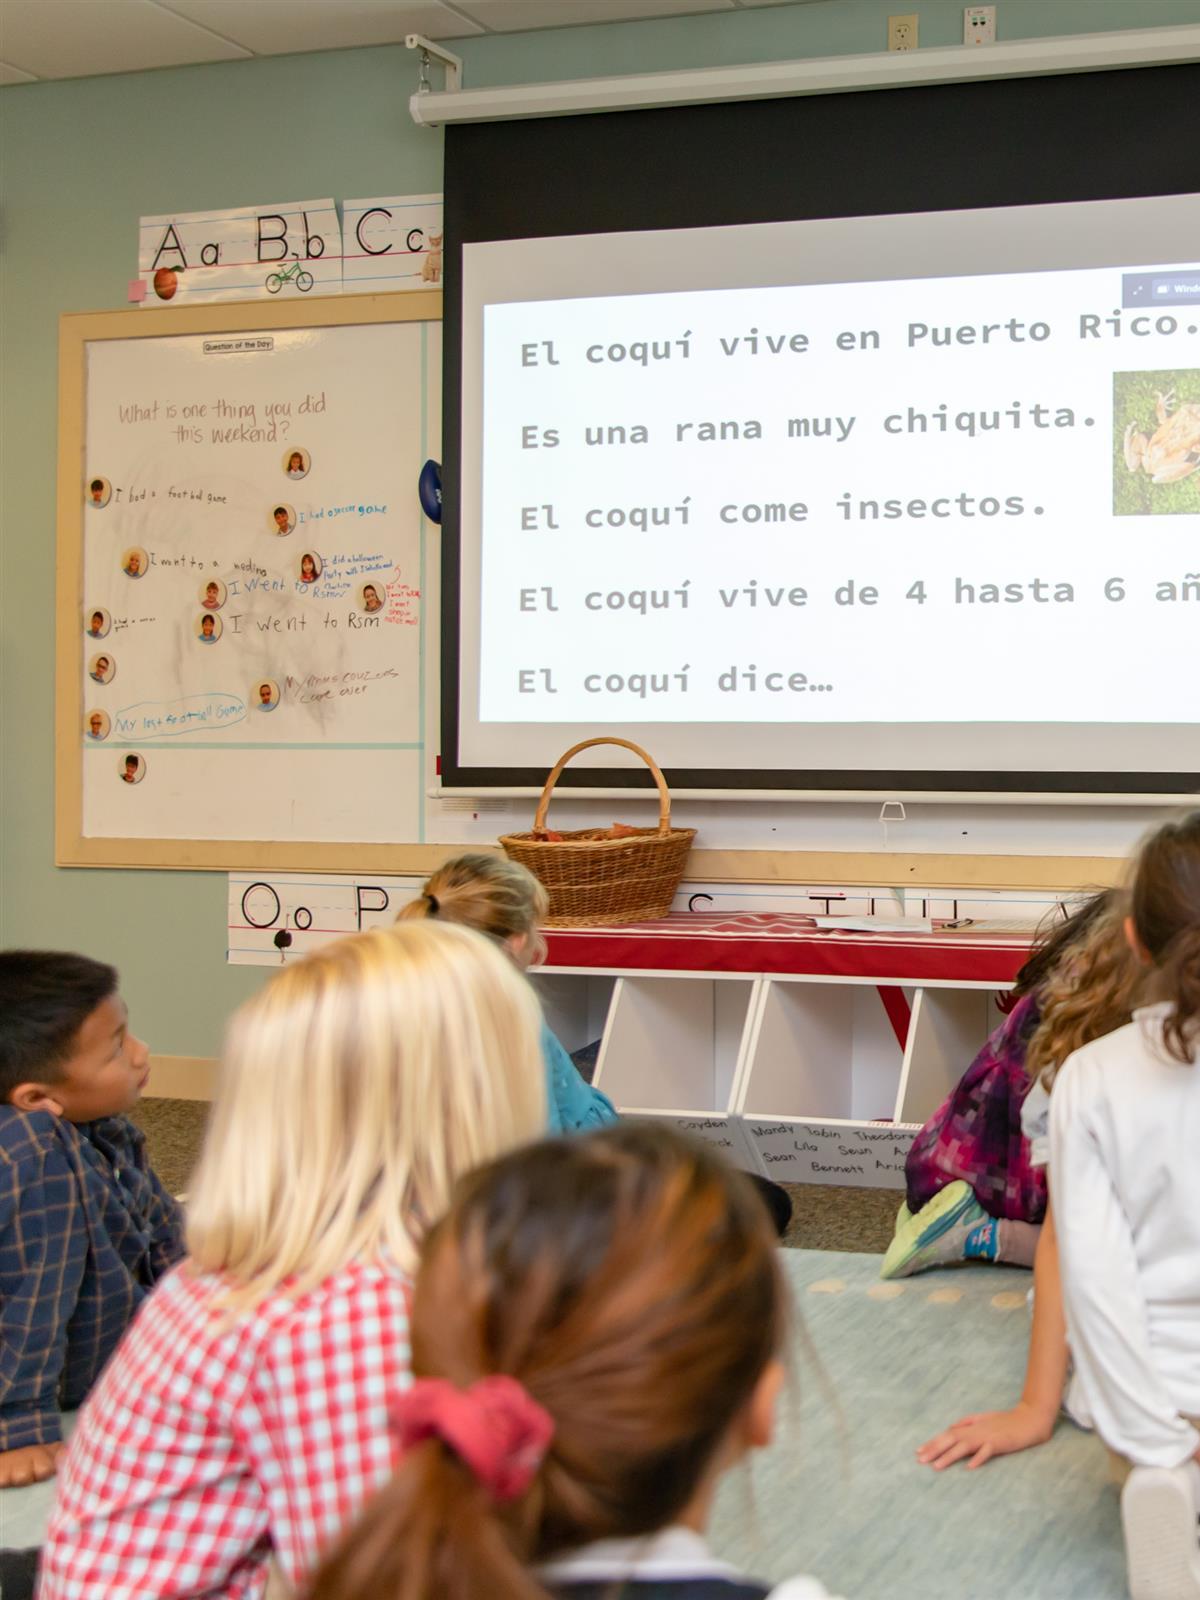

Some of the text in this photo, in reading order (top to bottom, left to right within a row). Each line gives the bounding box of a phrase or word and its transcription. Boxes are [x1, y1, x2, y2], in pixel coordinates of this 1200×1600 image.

[521, 309, 1199, 367] El coquí vive en Puerto Rico.
[119, 391, 326, 427] What is one thing you did
[521, 400, 1096, 449] Es una rana muy chiquita.
[171, 421, 290, 444] this weekend?
[521, 491, 1045, 532] El coquí come insectos.
[519, 586, 559, 612] El
[584, 579, 692, 615] coquí
[718, 579, 809, 608] vive
[834, 579, 880, 606] de
[905, 579, 928, 605] 4
[954, 577, 1076, 604] hasta
[1103, 576, 1127, 603] 6
[257, 613, 307, 633] went
[323, 612, 338, 629] to
[518, 667, 558, 694] El
[583, 663, 691, 699] coquí
[811, 1161, 864, 1175] Bennett
